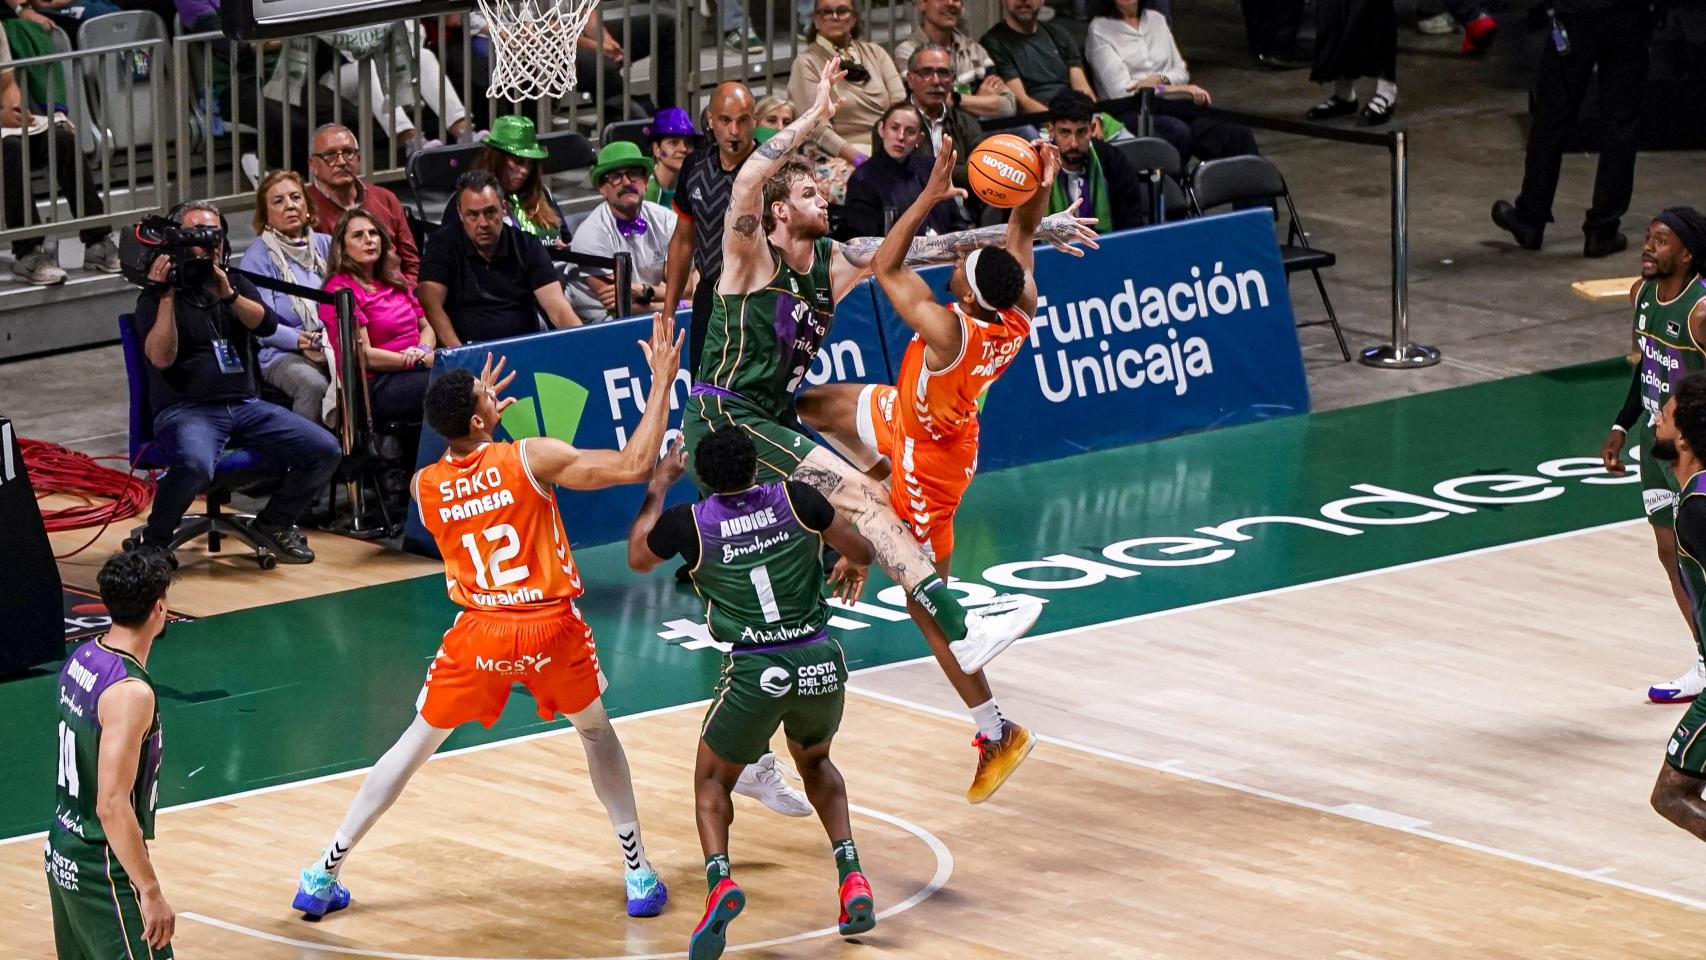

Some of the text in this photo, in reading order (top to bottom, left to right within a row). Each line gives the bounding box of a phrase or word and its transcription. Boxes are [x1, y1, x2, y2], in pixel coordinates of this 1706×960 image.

[982, 154, 1027, 186] Wilson
[1029, 261, 1270, 348] Fundación
[1033, 328, 1214, 403] Unicaja
[438, 466, 502, 502] SAKO
[438, 489, 514, 523] PAMESA
[720, 506, 777, 538] AUDIGE
[461, 523, 530, 590] 12
[749, 565, 781, 624] 1
[476, 655, 525, 672] MGS
[798, 661, 837, 678] COSTA
[798, 673, 838, 687] DEL SOL
[798, 683, 838, 696] MÁLAGA
[58, 720, 80, 799] 14
[60, 869, 79, 882] SOL
